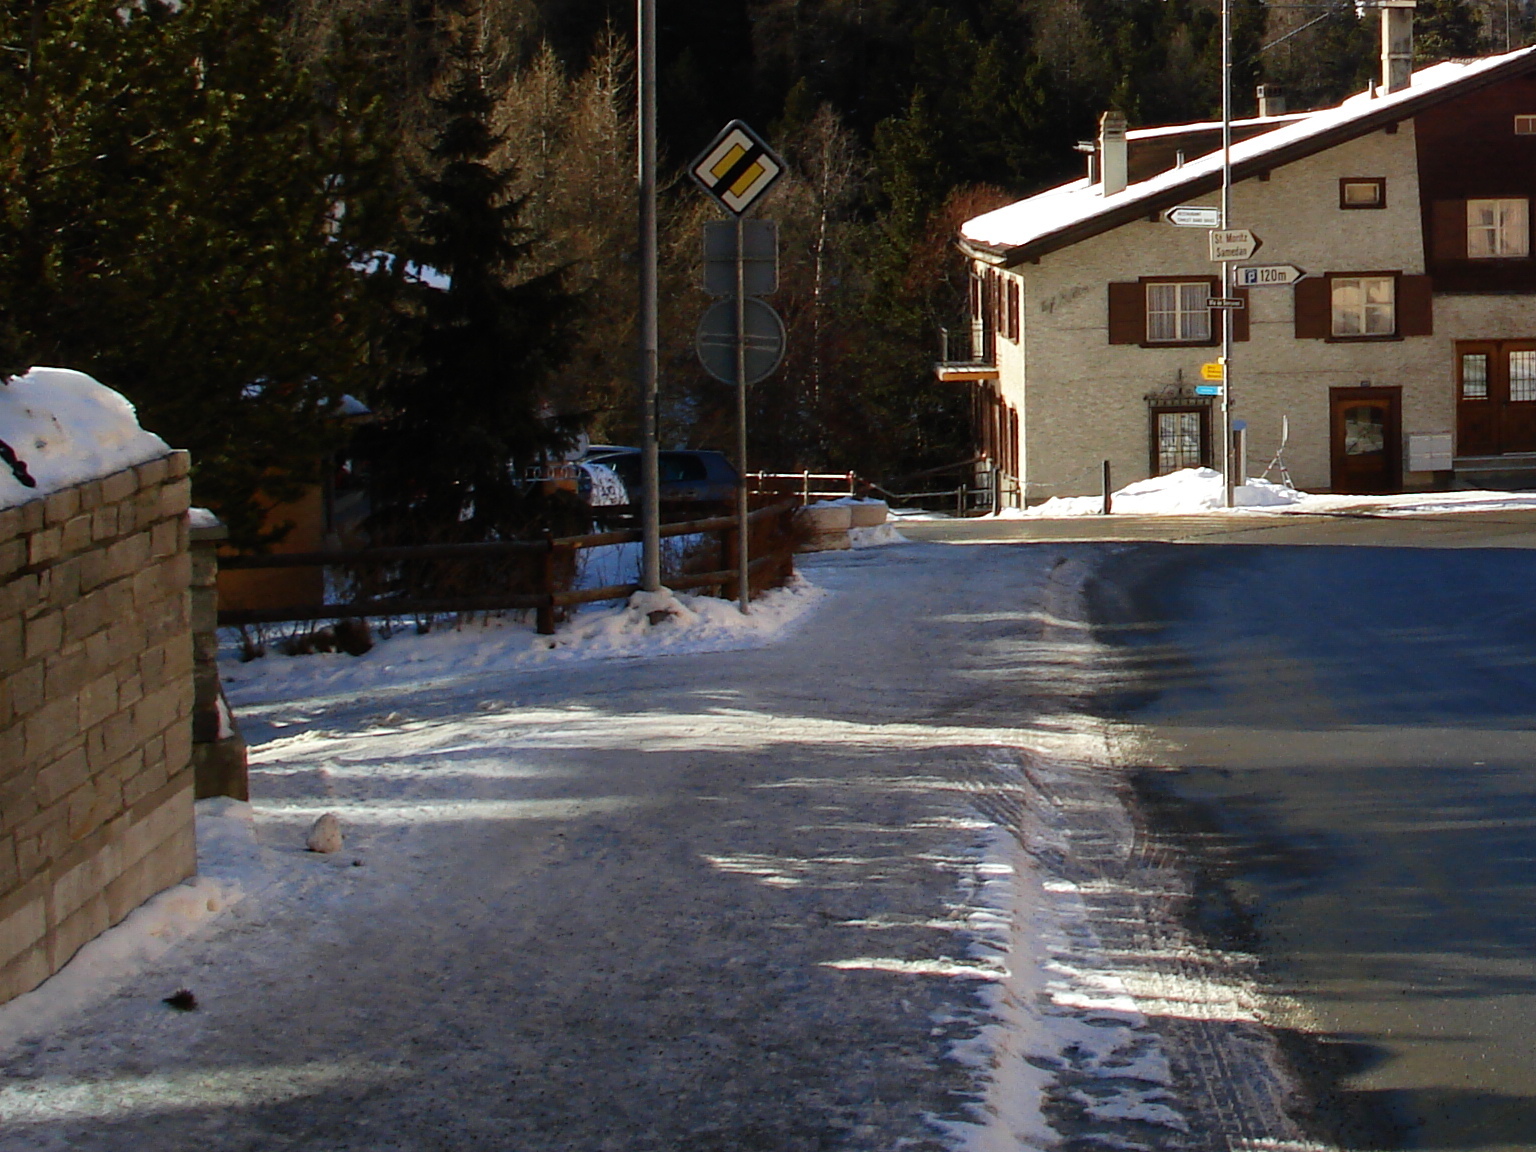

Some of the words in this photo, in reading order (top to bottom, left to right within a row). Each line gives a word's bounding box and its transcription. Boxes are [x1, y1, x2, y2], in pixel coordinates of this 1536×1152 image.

[1226, 232, 1247, 243] Moritz
[1217, 246, 1247, 258] Samedan
[1261, 269, 1287, 282] 120m
